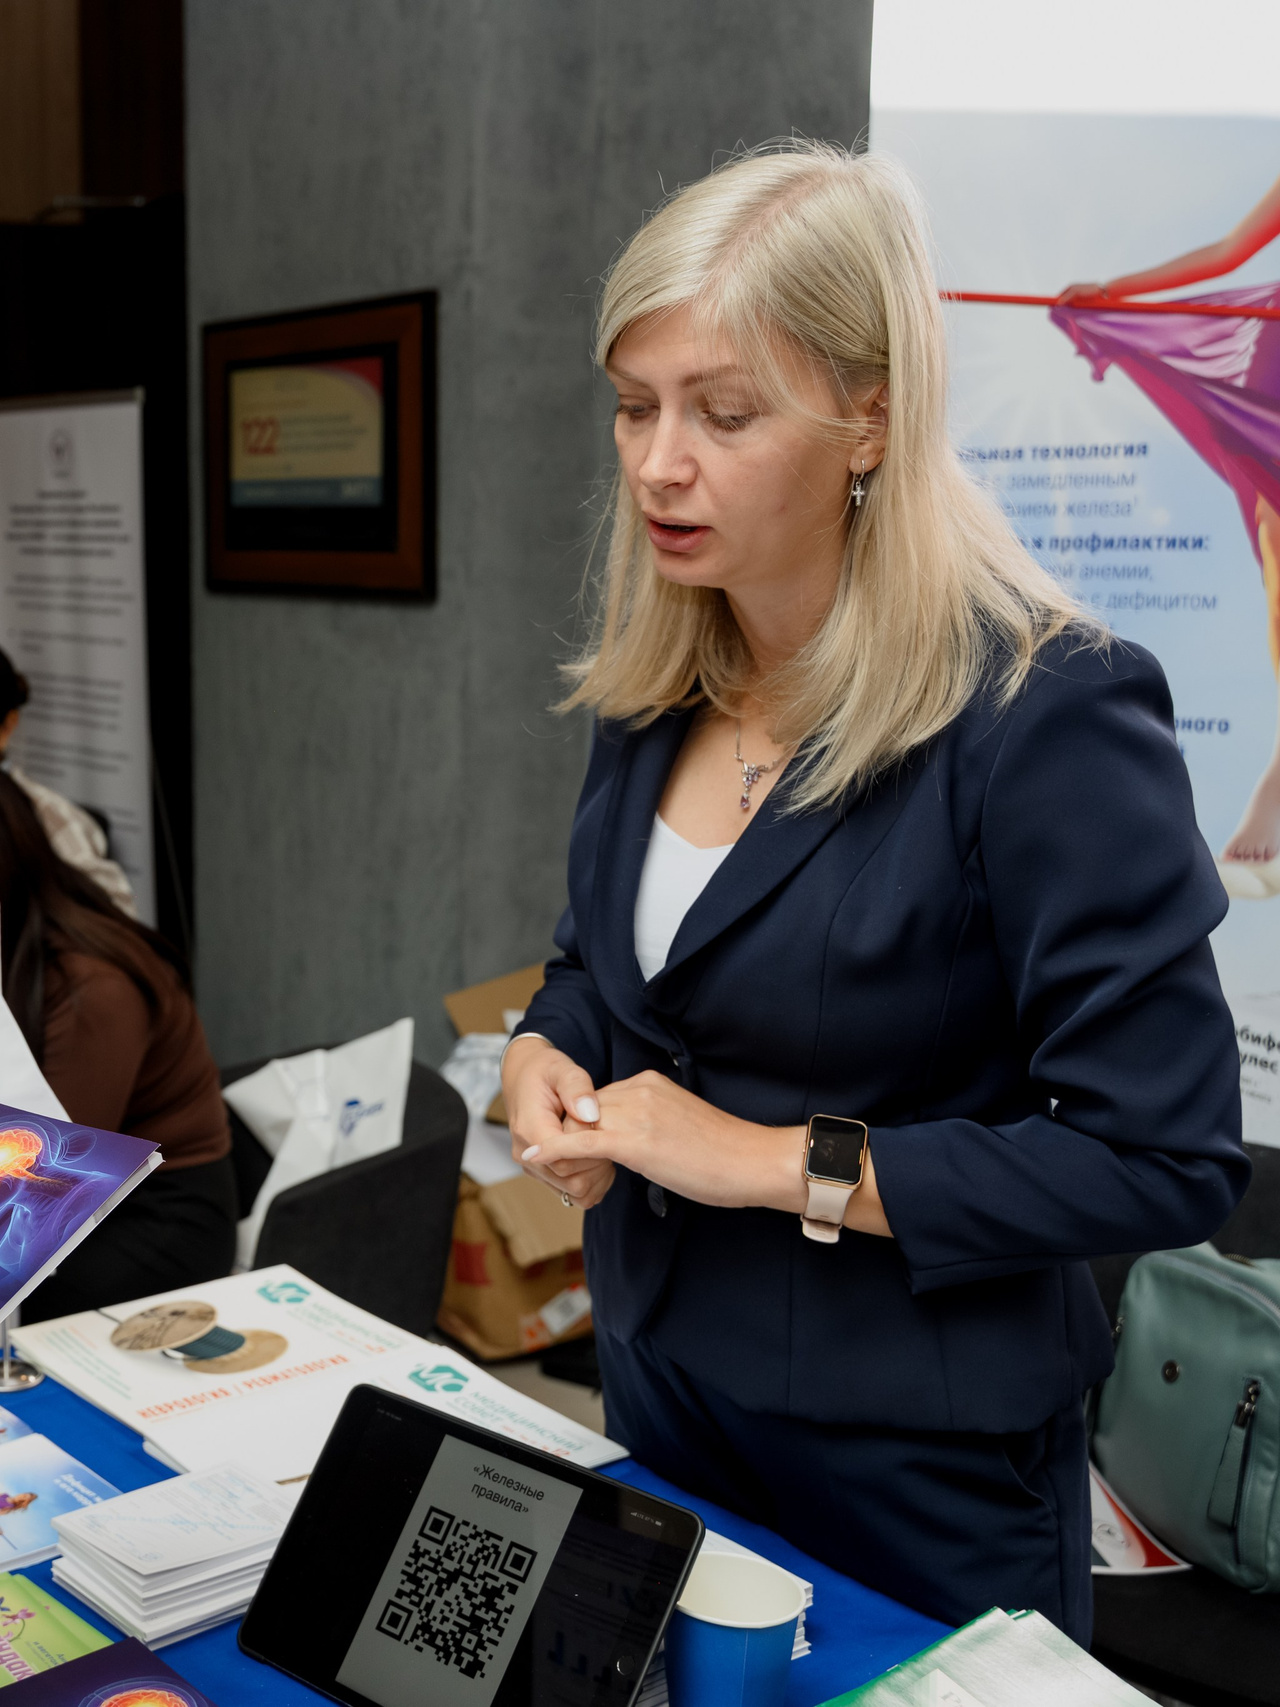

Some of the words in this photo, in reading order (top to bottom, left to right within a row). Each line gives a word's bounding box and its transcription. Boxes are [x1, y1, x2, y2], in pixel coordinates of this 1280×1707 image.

[1031, 441, 1148, 461] технология
[1011, 471, 1137, 491] замедленным
[1049, 531, 1210, 555] профилактики:
[1079, 563, 1153, 582] анемии,
[1106, 589, 1217, 612] дефицитом
[137, 1386, 232, 1419] НЕВРОЛОГИЯ
[243, 1353, 350, 1390] РЕВМАТОЛОГИЯ
[473, 1464, 545, 1501] «Железные
[471, 1483, 529, 1514] правила»
